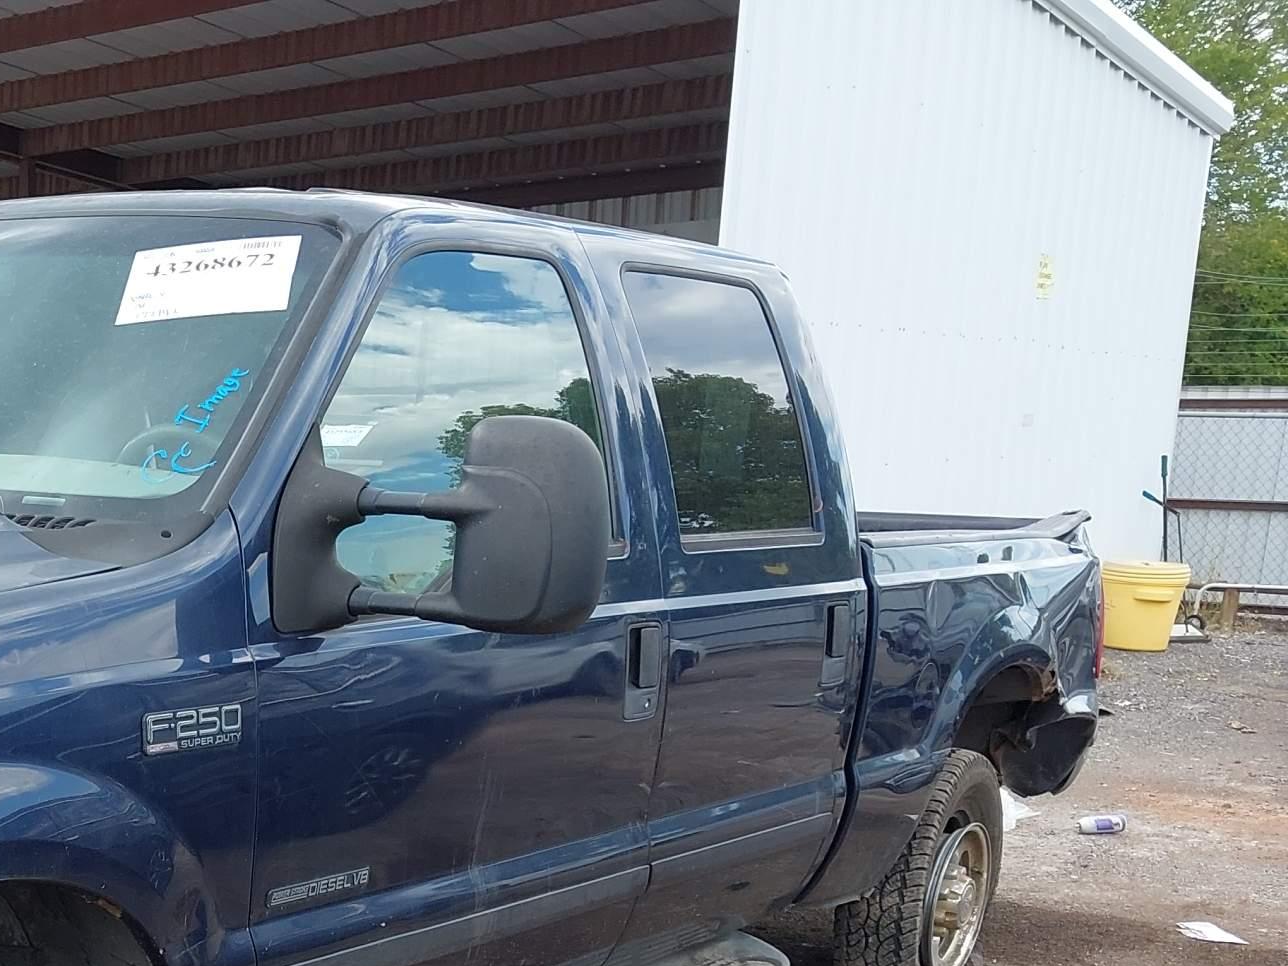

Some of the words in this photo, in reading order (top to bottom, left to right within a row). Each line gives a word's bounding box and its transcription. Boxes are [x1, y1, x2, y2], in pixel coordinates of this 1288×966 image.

[145, 253, 275, 277] 43268672
[180, 736, 214, 749] SUPER
[215, 732, 242, 744] DUTY
[308, 875, 352, 897] DIESEL
